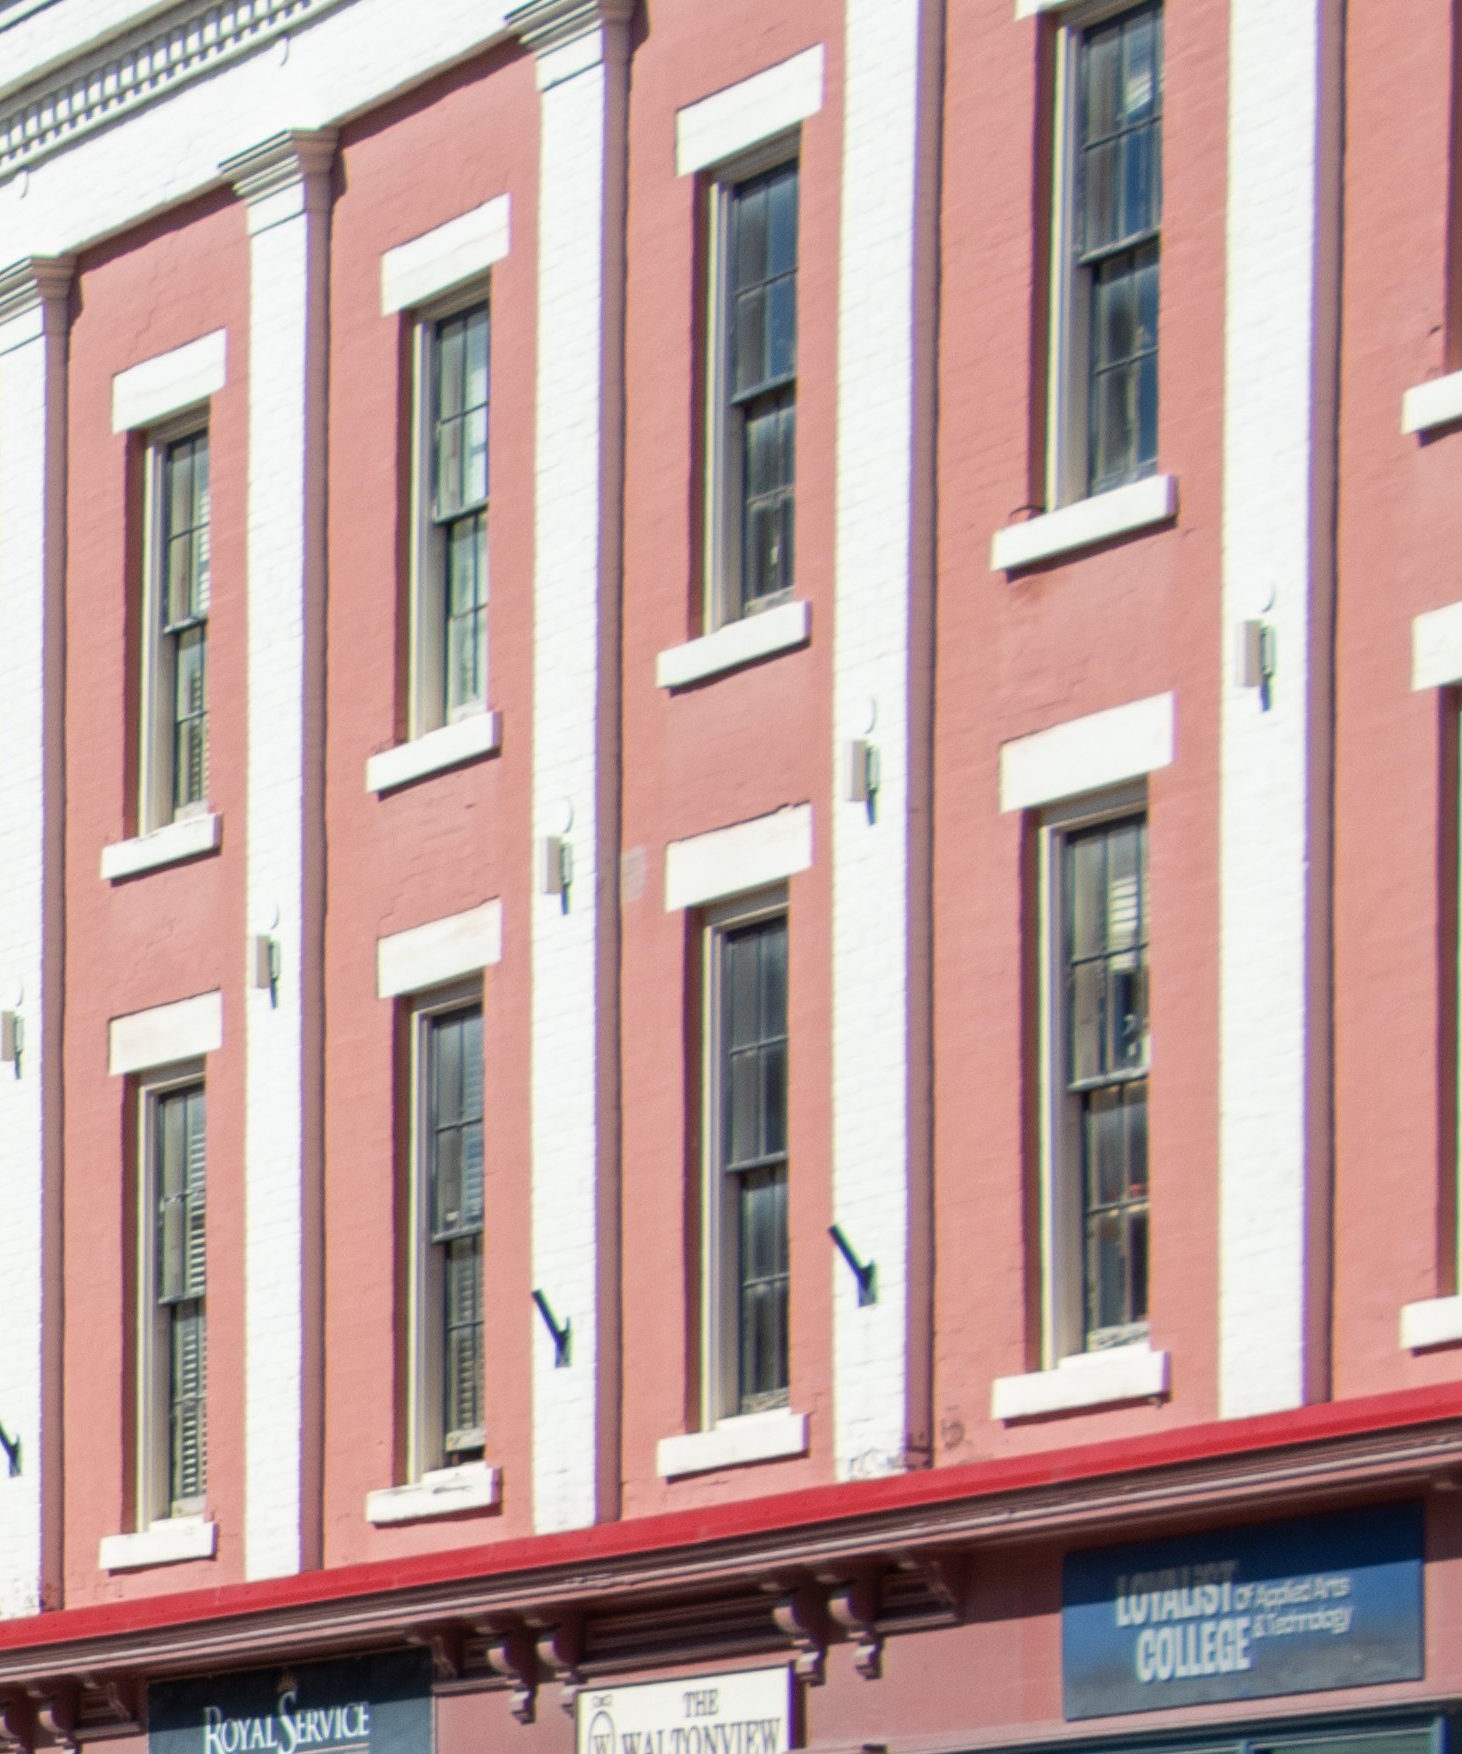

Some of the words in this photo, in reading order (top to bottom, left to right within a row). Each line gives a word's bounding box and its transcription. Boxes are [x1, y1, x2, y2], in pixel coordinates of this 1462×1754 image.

[1116, 1560, 1239, 1628] LOYALIST
[1255, 1577, 1312, 1608] Applied
[1313, 1576, 1351, 1600] Arts
[1136, 1616, 1252, 1683] COLLEGE
[1265, 1606, 1355, 1636] Technology
[684, 1689, 719, 1718] THE
